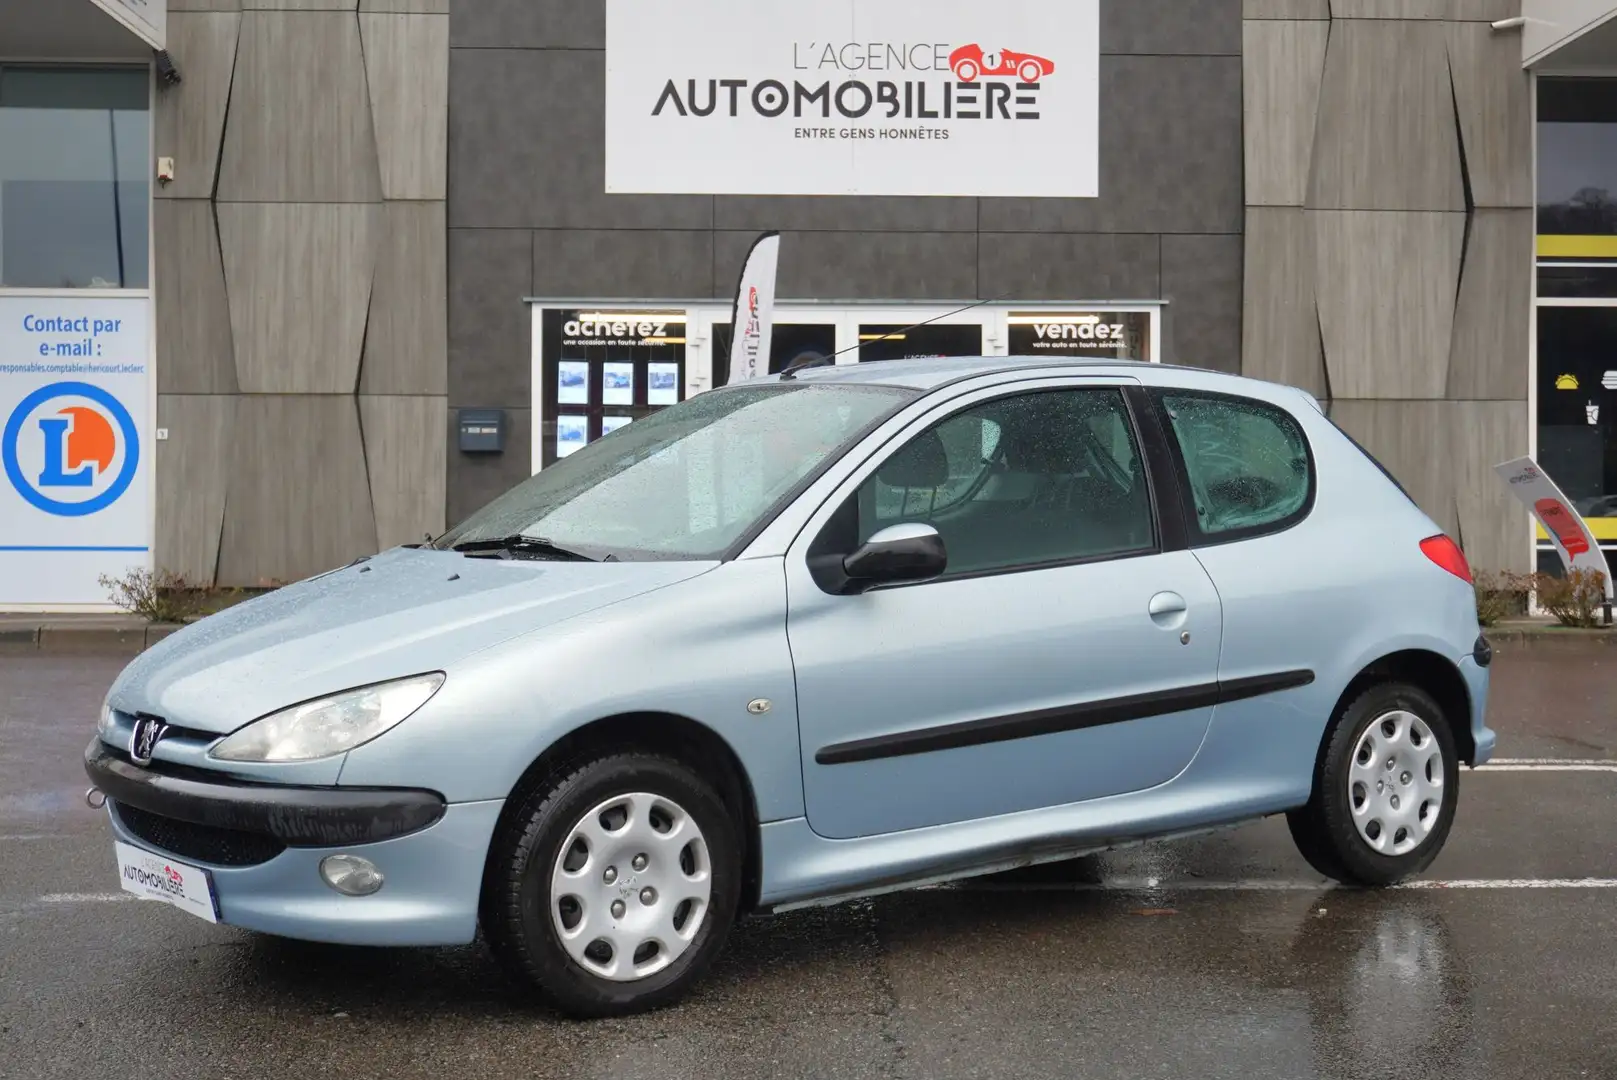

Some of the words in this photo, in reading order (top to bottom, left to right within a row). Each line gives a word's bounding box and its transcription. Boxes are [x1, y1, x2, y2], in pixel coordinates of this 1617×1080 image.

[794, 42, 949, 70] L'AGENCE
[988, 54, 994, 66] 1
[651, 78, 1040, 119] AUTOMOBILIERE
[794, 128, 835, 139] ENTRE
[840, 128, 875, 139] GENS
[879, 125, 949, 140] HONNÊTES
[23, 314, 88, 332] Contact
[93, 319, 121, 337] par
[1033, 315, 1124, 339] vendez
[39, 338, 92, 357] e-mail
[577, 338, 606, 346] occasion
[617, 338, 637, 346] toute
[1032, 341, 1050, 349] votre
[1052, 341, 1068, 349] auto
[1080, 341, 1097, 349] toute
